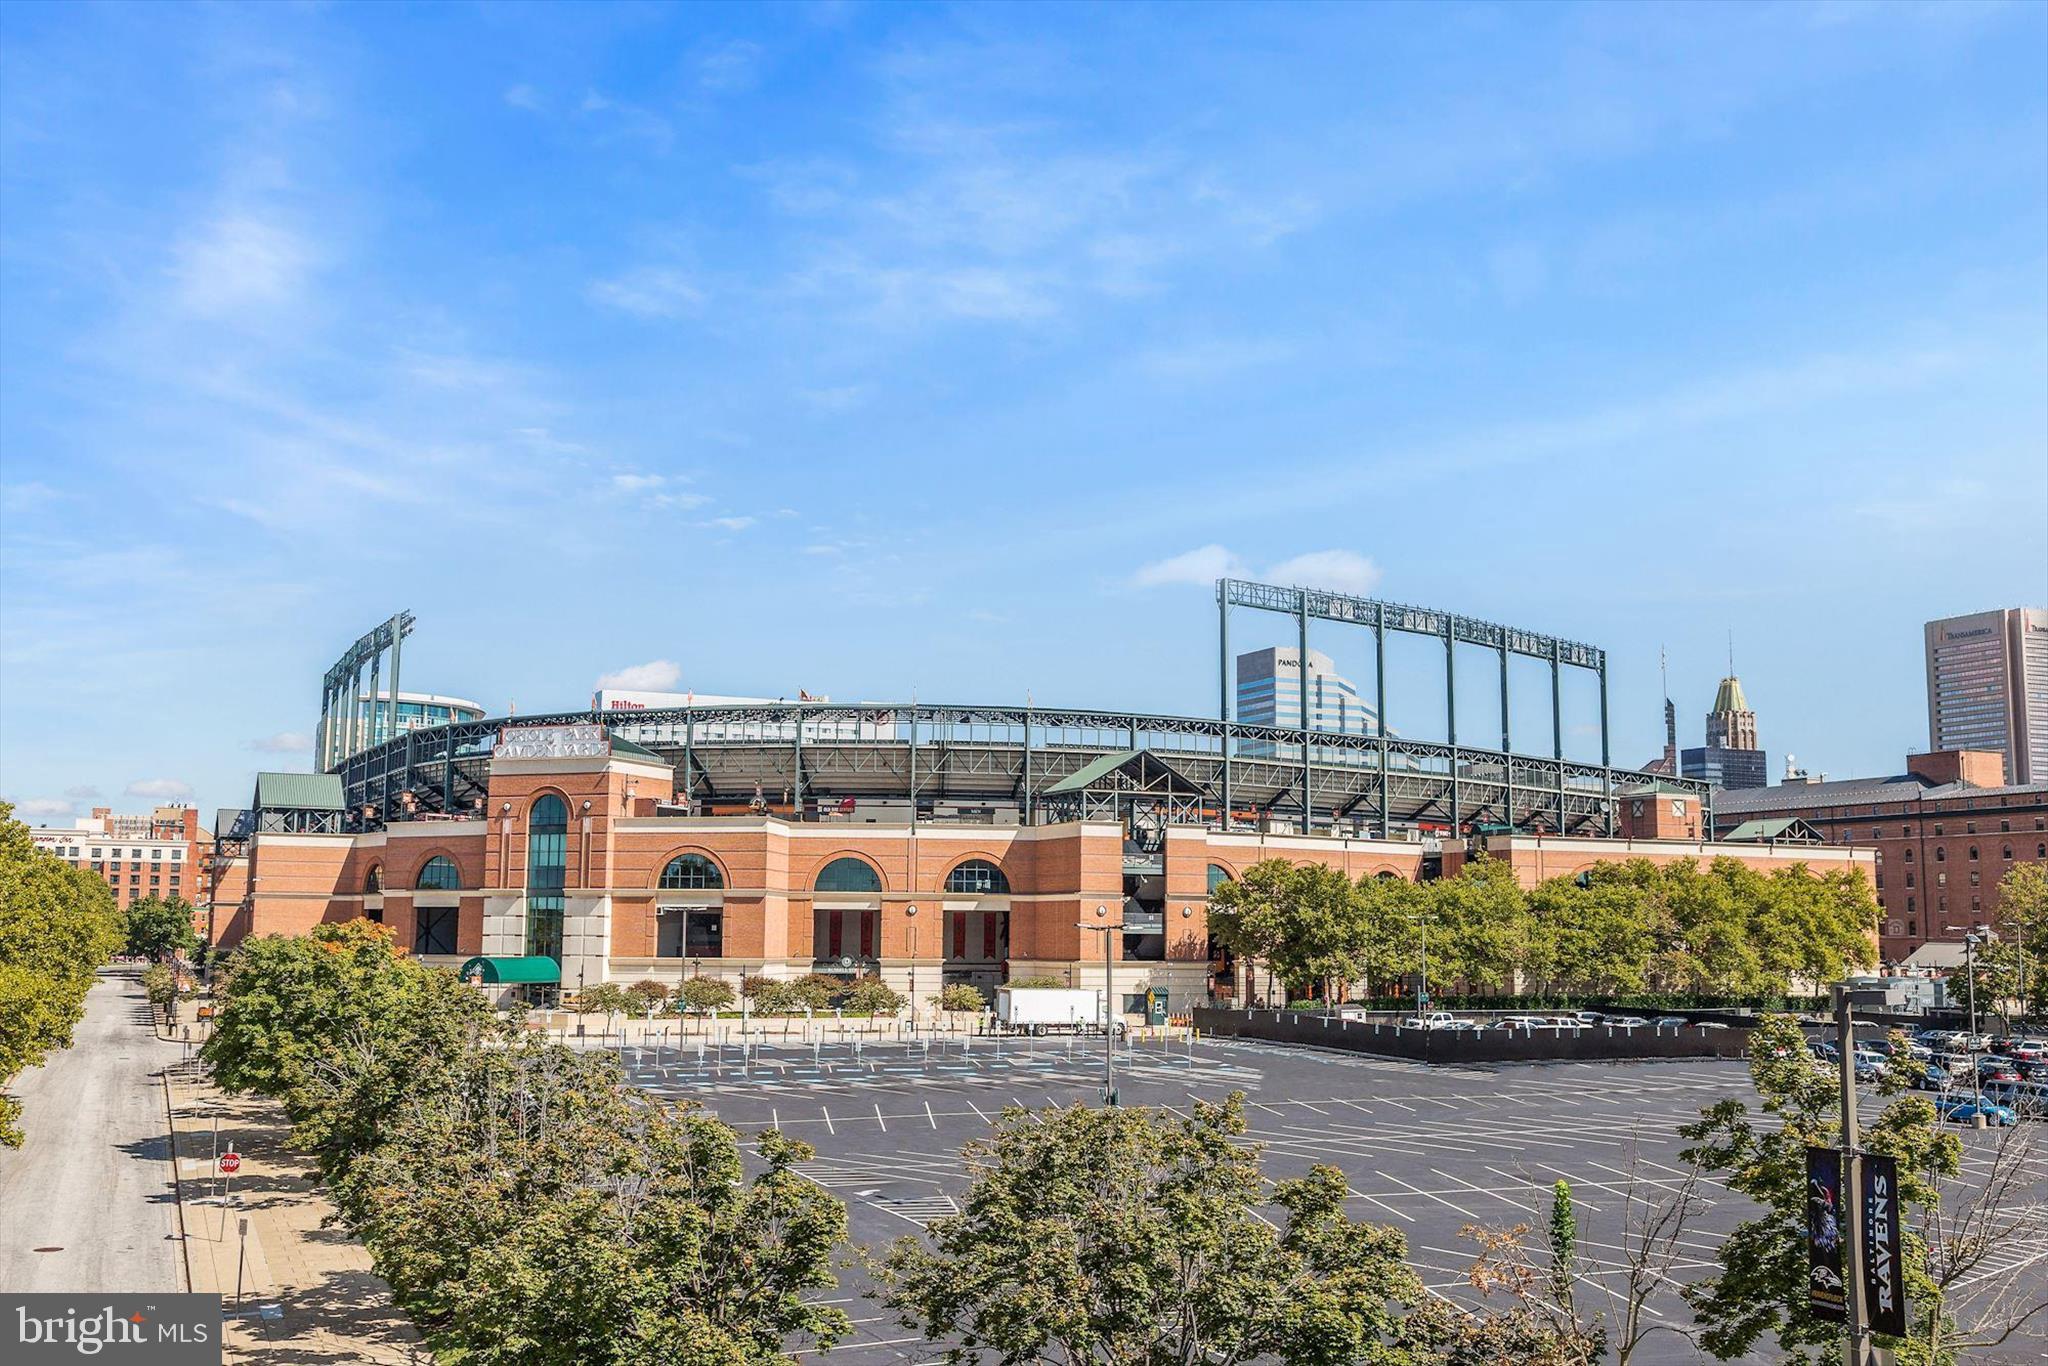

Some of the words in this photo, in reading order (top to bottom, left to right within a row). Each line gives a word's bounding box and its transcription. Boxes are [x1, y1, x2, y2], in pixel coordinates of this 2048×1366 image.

[1278, 659, 1313, 668] PANDOA
[611, 700, 645, 709] Hilton
[505, 729, 555, 742] ORIOLE
[564, 727, 600, 740] PARK
[494, 742, 558, 758] CAMDEN
[563, 742, 609, 757] YARDS
[220, 1159, 240, 1168] STOP
[1868, 1197, 1877, 1285] BALTIMORE
[1874, 1174, 1893, 1314] RAVENS
